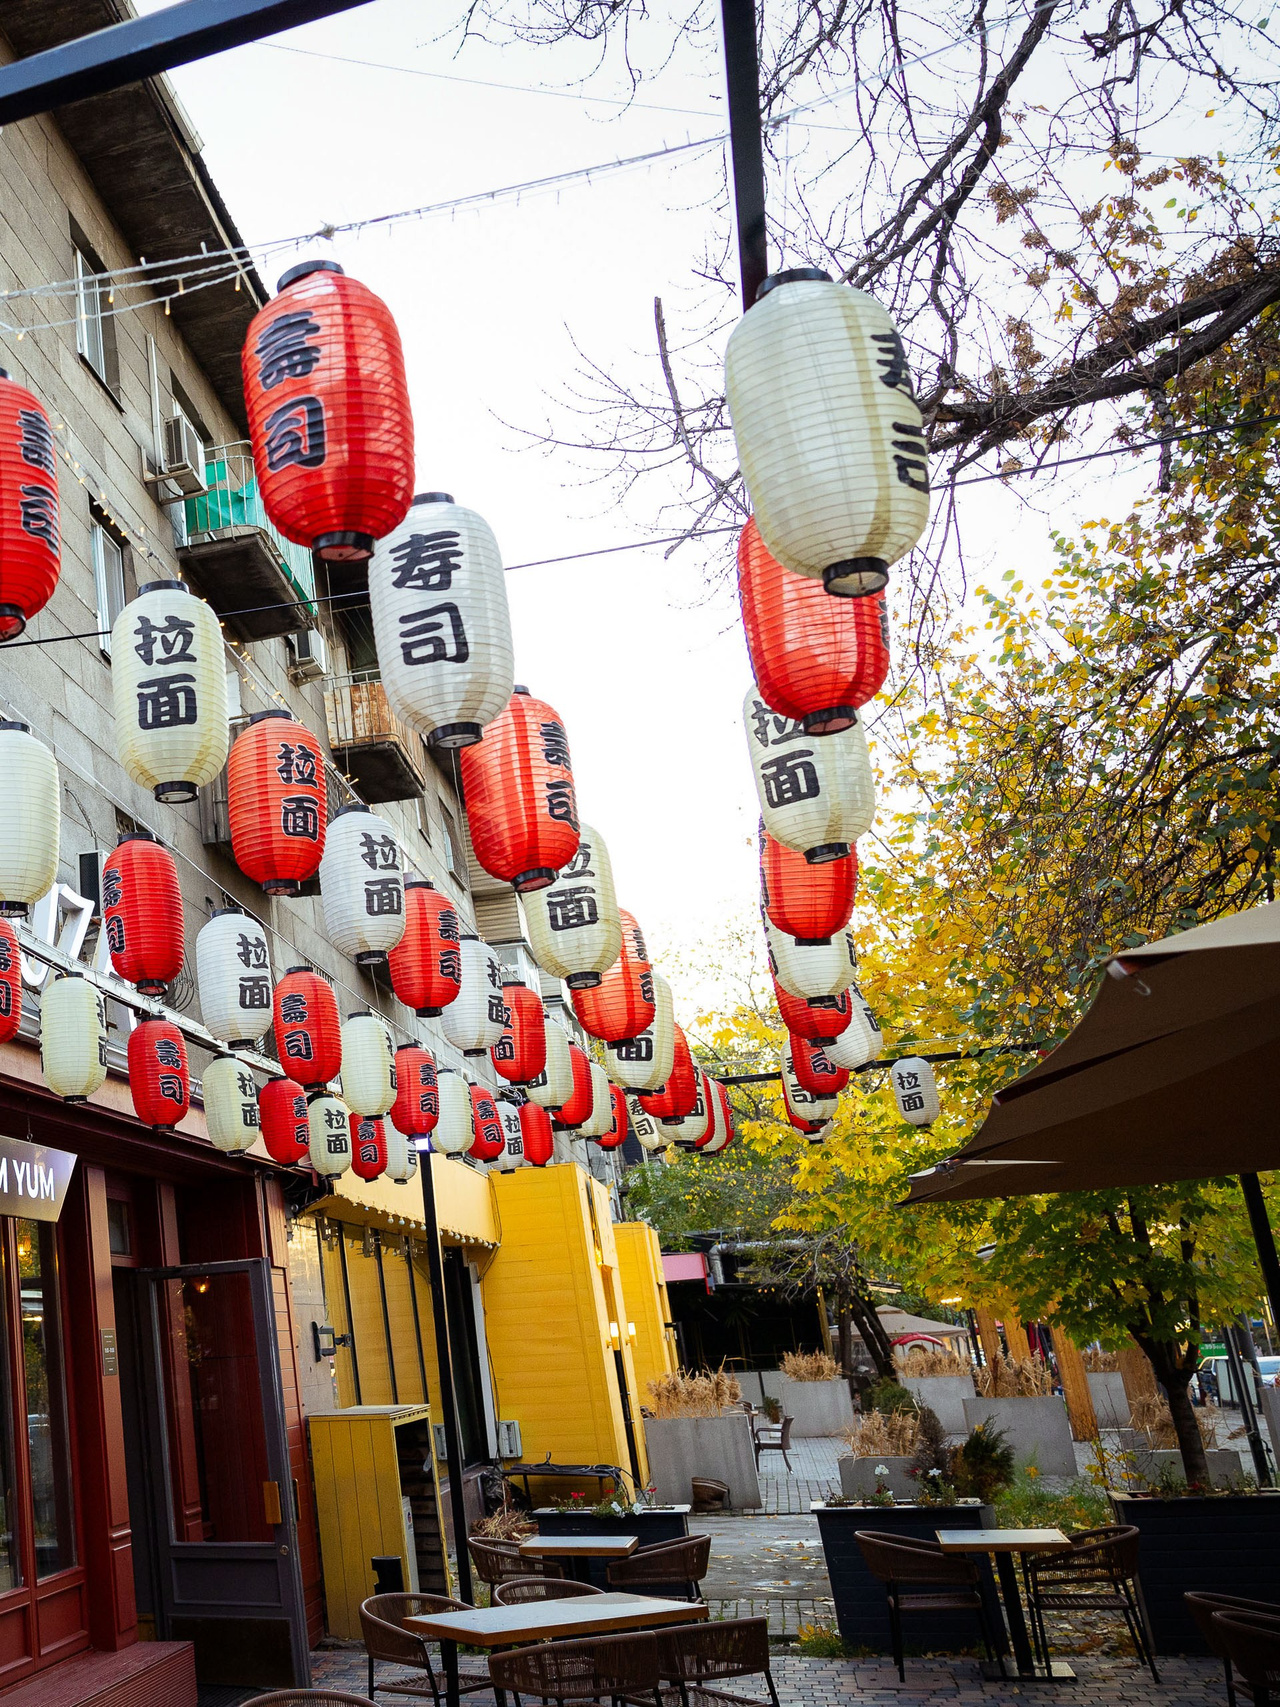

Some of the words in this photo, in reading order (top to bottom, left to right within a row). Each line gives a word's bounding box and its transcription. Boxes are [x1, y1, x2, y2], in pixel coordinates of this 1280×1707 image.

[133, 615, 198, 731] 拉面
[276, 742, 320, 844] 拉面
[359, 832, 402, 917] 拉面
[236, 933, 271, 1010] 拉面
[896, 1071, 925, 1112] 拉面
[324, 1107, 349, 1155] 拉面
[504, 1114, 523, 1156] 拉面
[12, 1159, 56, 1202] YUM
